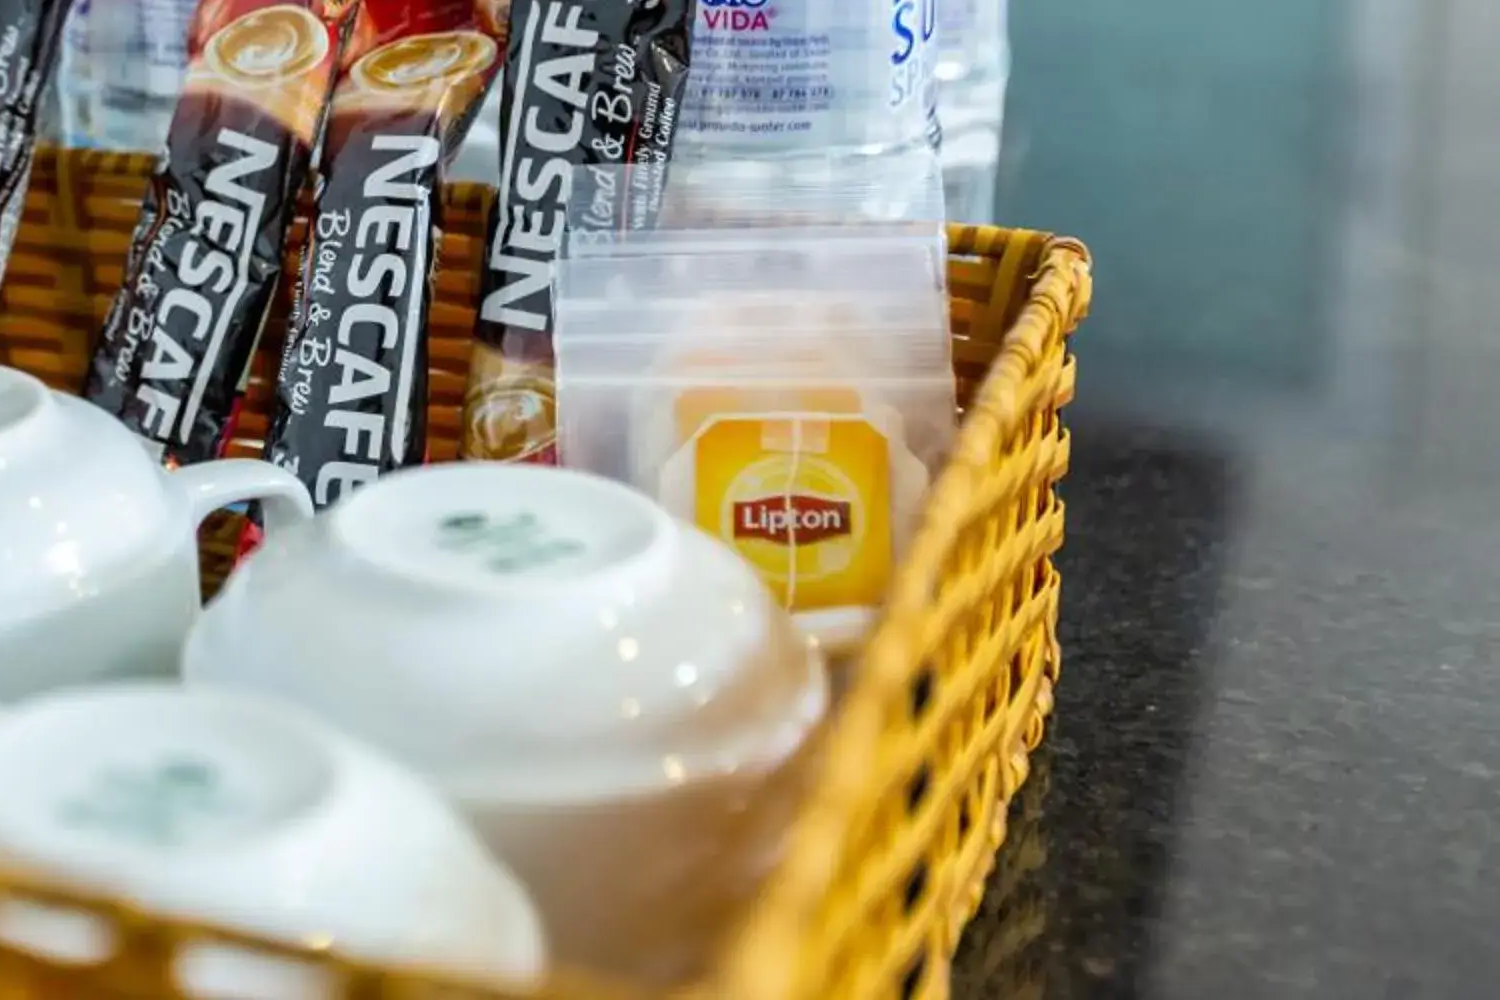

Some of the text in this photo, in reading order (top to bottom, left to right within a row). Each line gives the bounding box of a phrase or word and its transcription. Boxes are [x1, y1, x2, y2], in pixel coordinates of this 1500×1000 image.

[703, 9, 769, 32] VIDA
[638, 81, 661, 140] Ground
[655, 96, 676, 147] Coffee
[569, 43, 638, 250] Blend & Brew
[147, 187, 191, 272] Blend
[135, 272, 160, 300] &
[137, 127, 278, 444] NESCAF
[290, 207, 351, 416] Blend & Brew
[114, 306, 156, 383] Brew
[741, 505, 842, 534] Lipton
